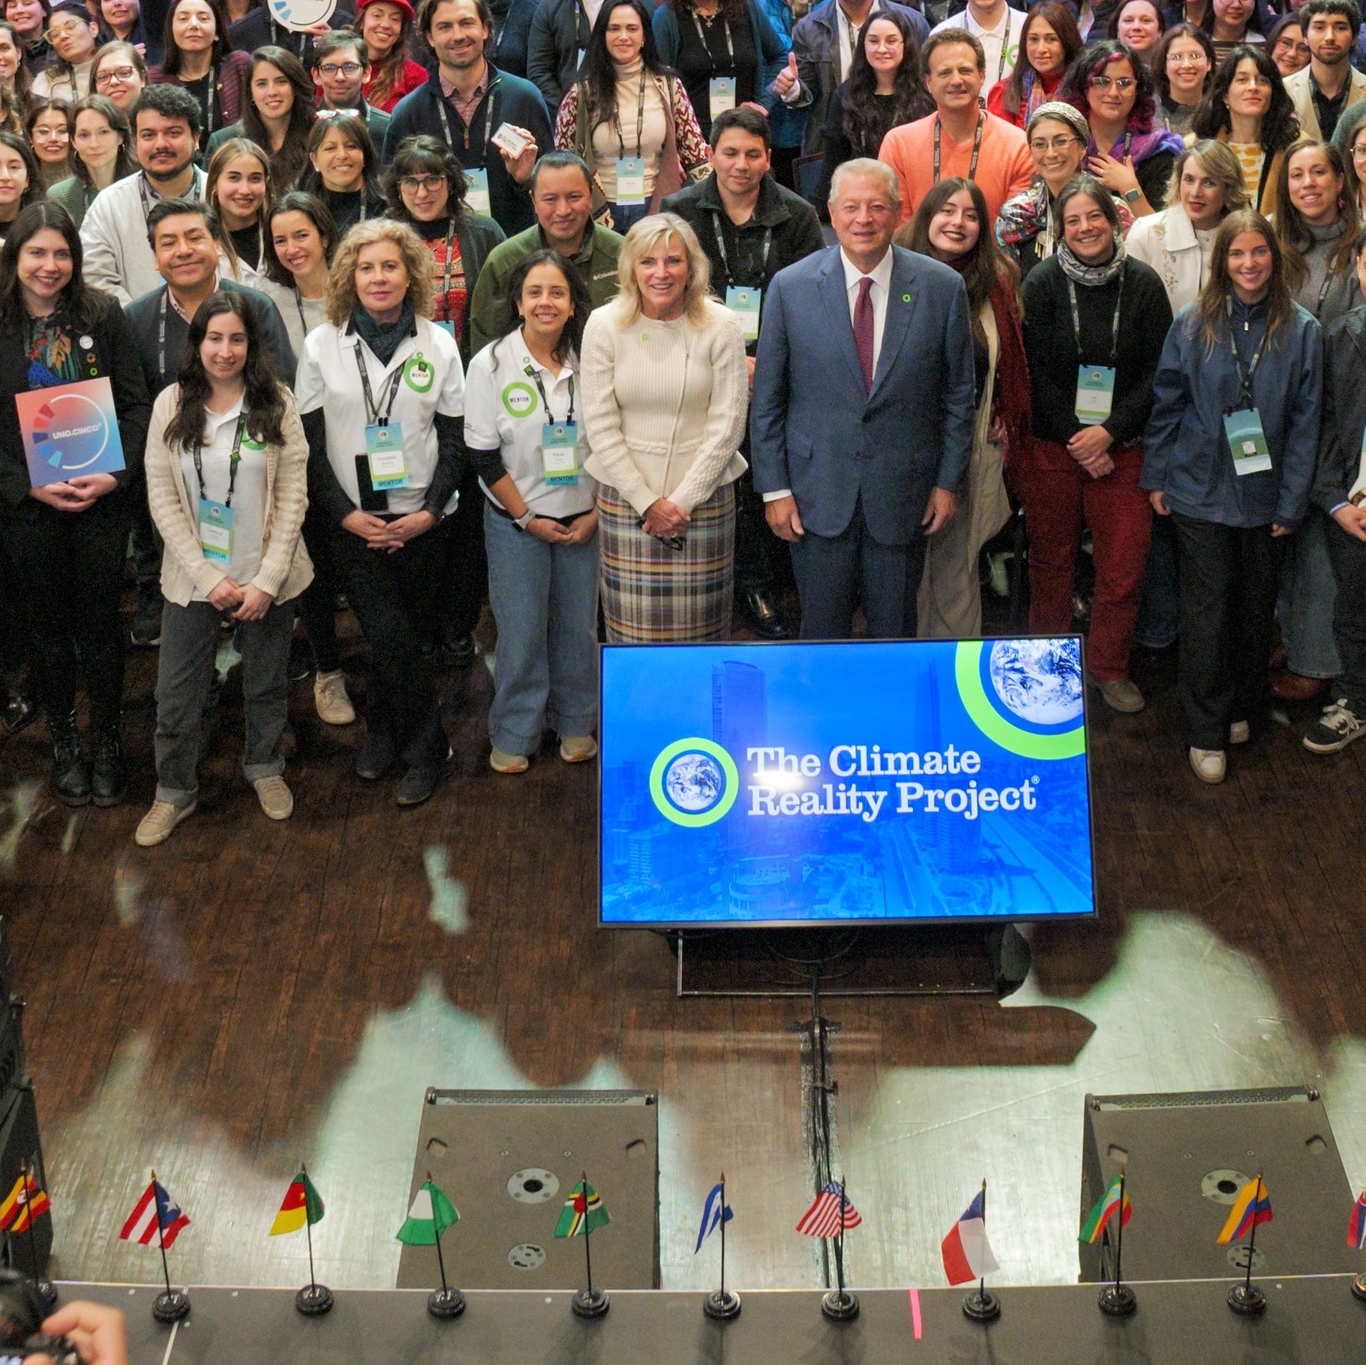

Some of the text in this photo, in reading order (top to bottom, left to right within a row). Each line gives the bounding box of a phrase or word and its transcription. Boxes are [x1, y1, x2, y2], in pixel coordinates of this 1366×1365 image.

[378, 479, 404, 487] MENTOR
[550, 475, 574, 483] MENTOR
[747, 744, 981, 778] The Climate
[747, 780, 887, 822] Reality
